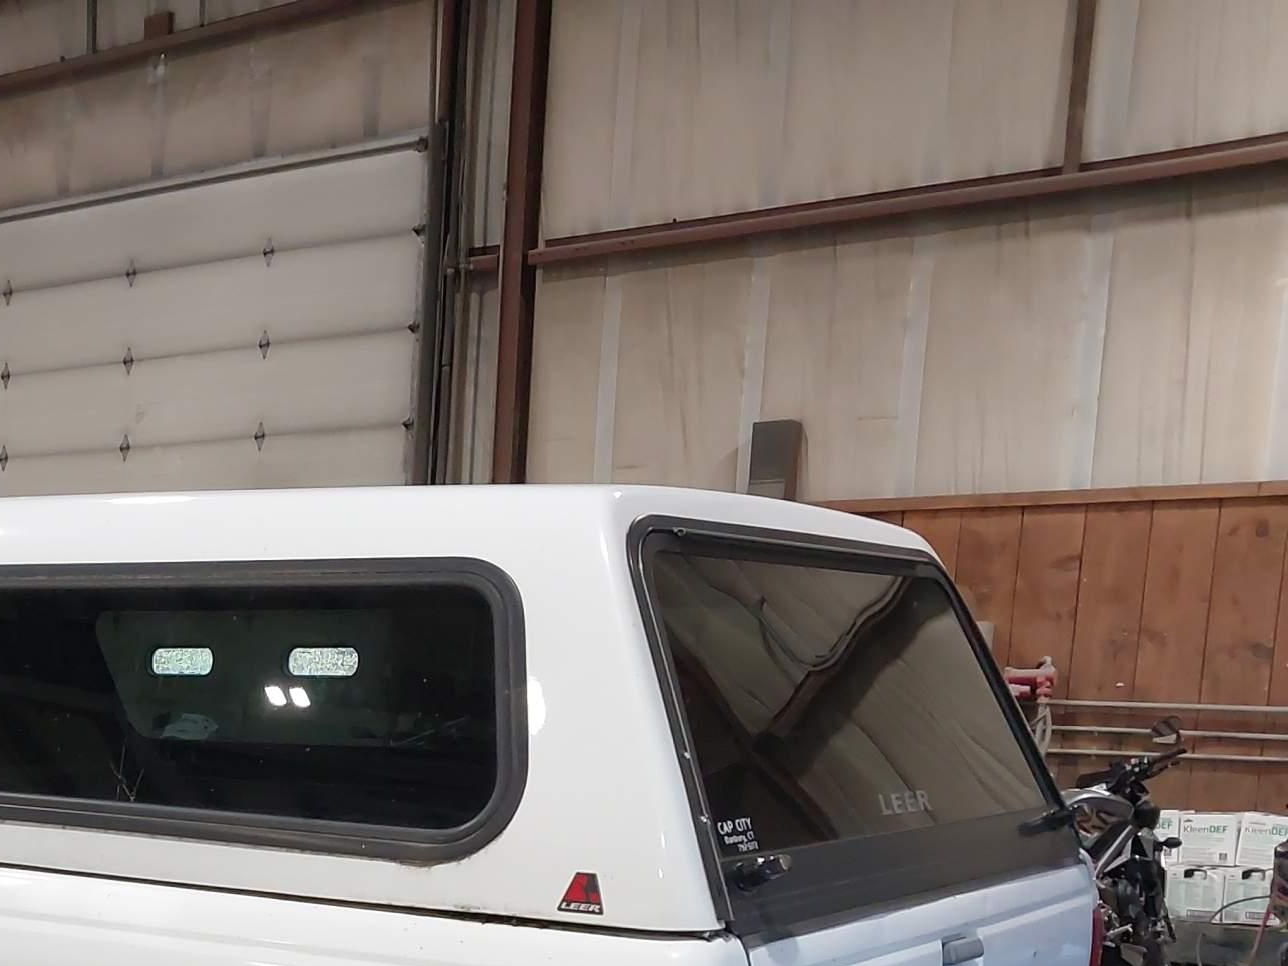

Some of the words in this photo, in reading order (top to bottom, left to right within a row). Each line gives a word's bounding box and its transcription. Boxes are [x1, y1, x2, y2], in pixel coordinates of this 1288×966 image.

[878, 790, 932, 816] LEER
[717, 820, 733, 835] CAP
[735, 817, 752, 831] CITY
[1183, 823, 1229, 834] KleenDEF
[560, 901, 601, 913] LEER
